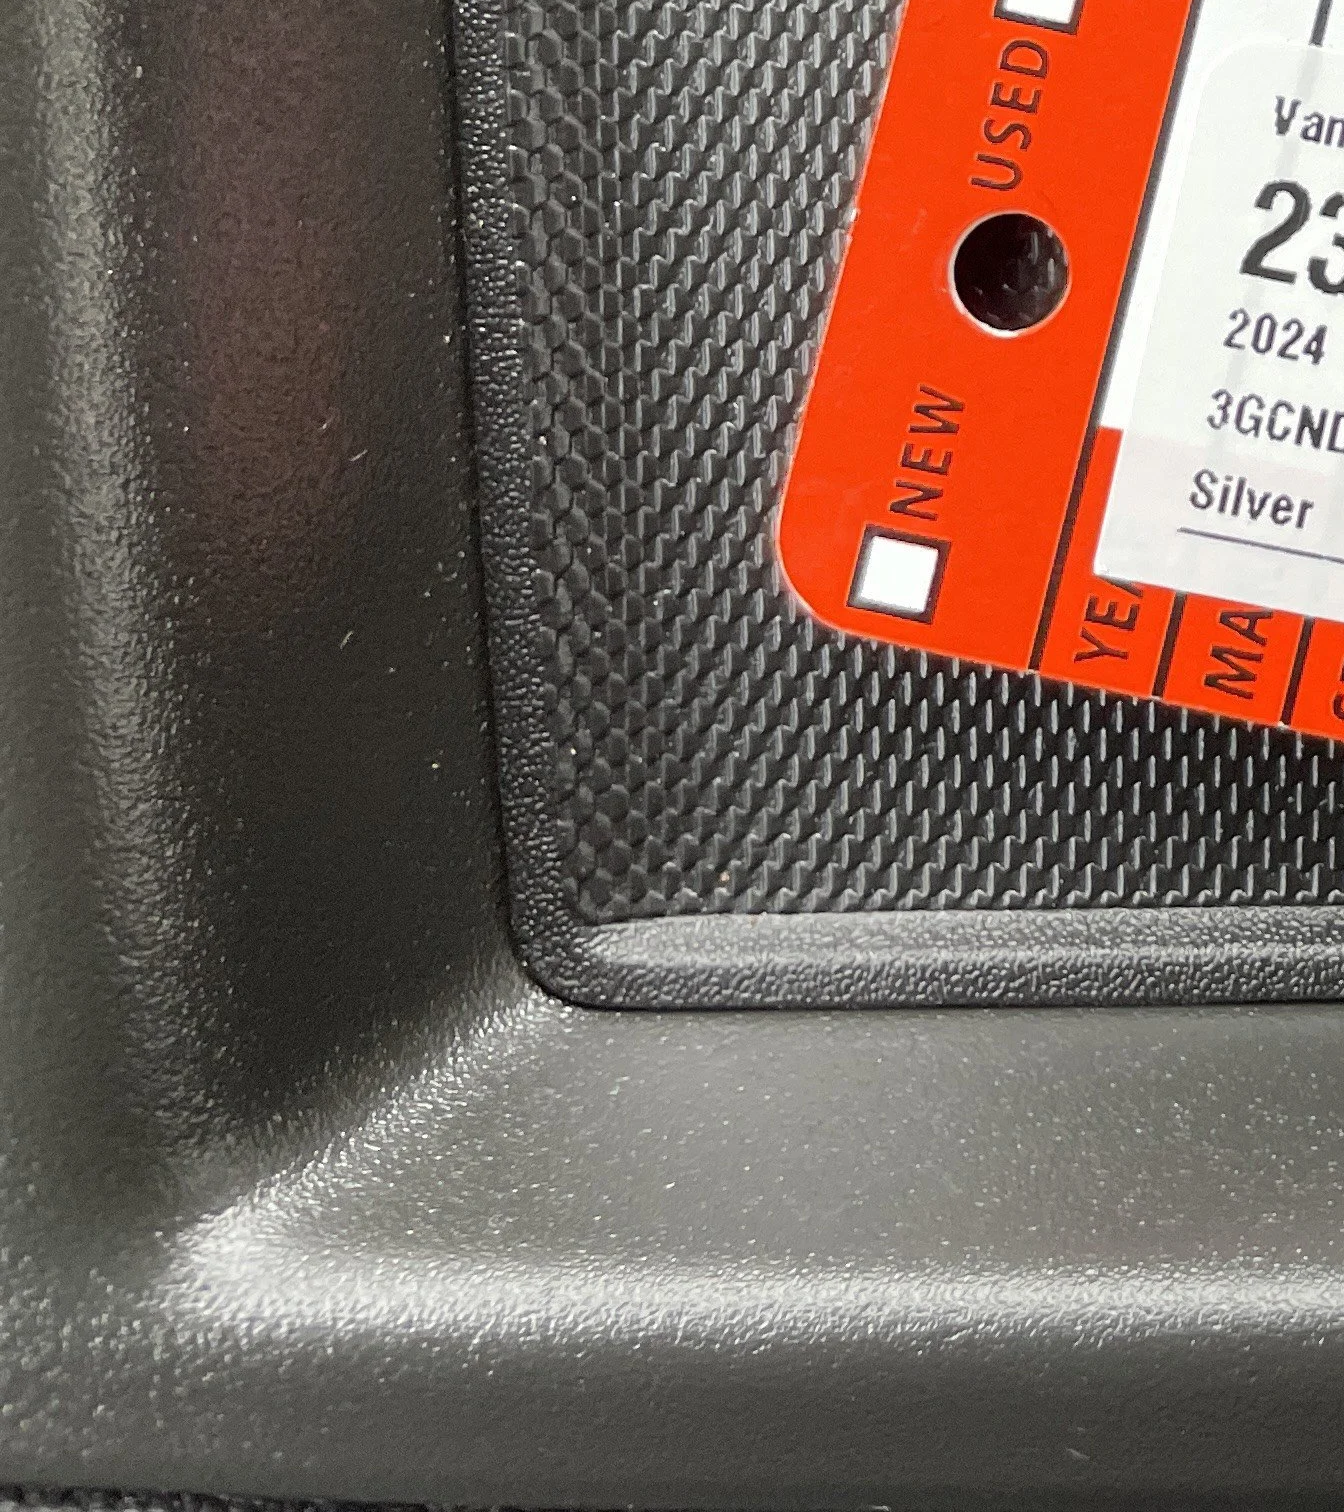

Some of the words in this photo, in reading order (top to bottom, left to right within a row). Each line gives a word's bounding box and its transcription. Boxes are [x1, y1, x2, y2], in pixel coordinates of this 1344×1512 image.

[970, 39, 1049, 192] USED
[1222, 308, 1329, 366] 2024
[889, 385, 965, 522] NEW
[1188, 469, 1315, 531] Silver
